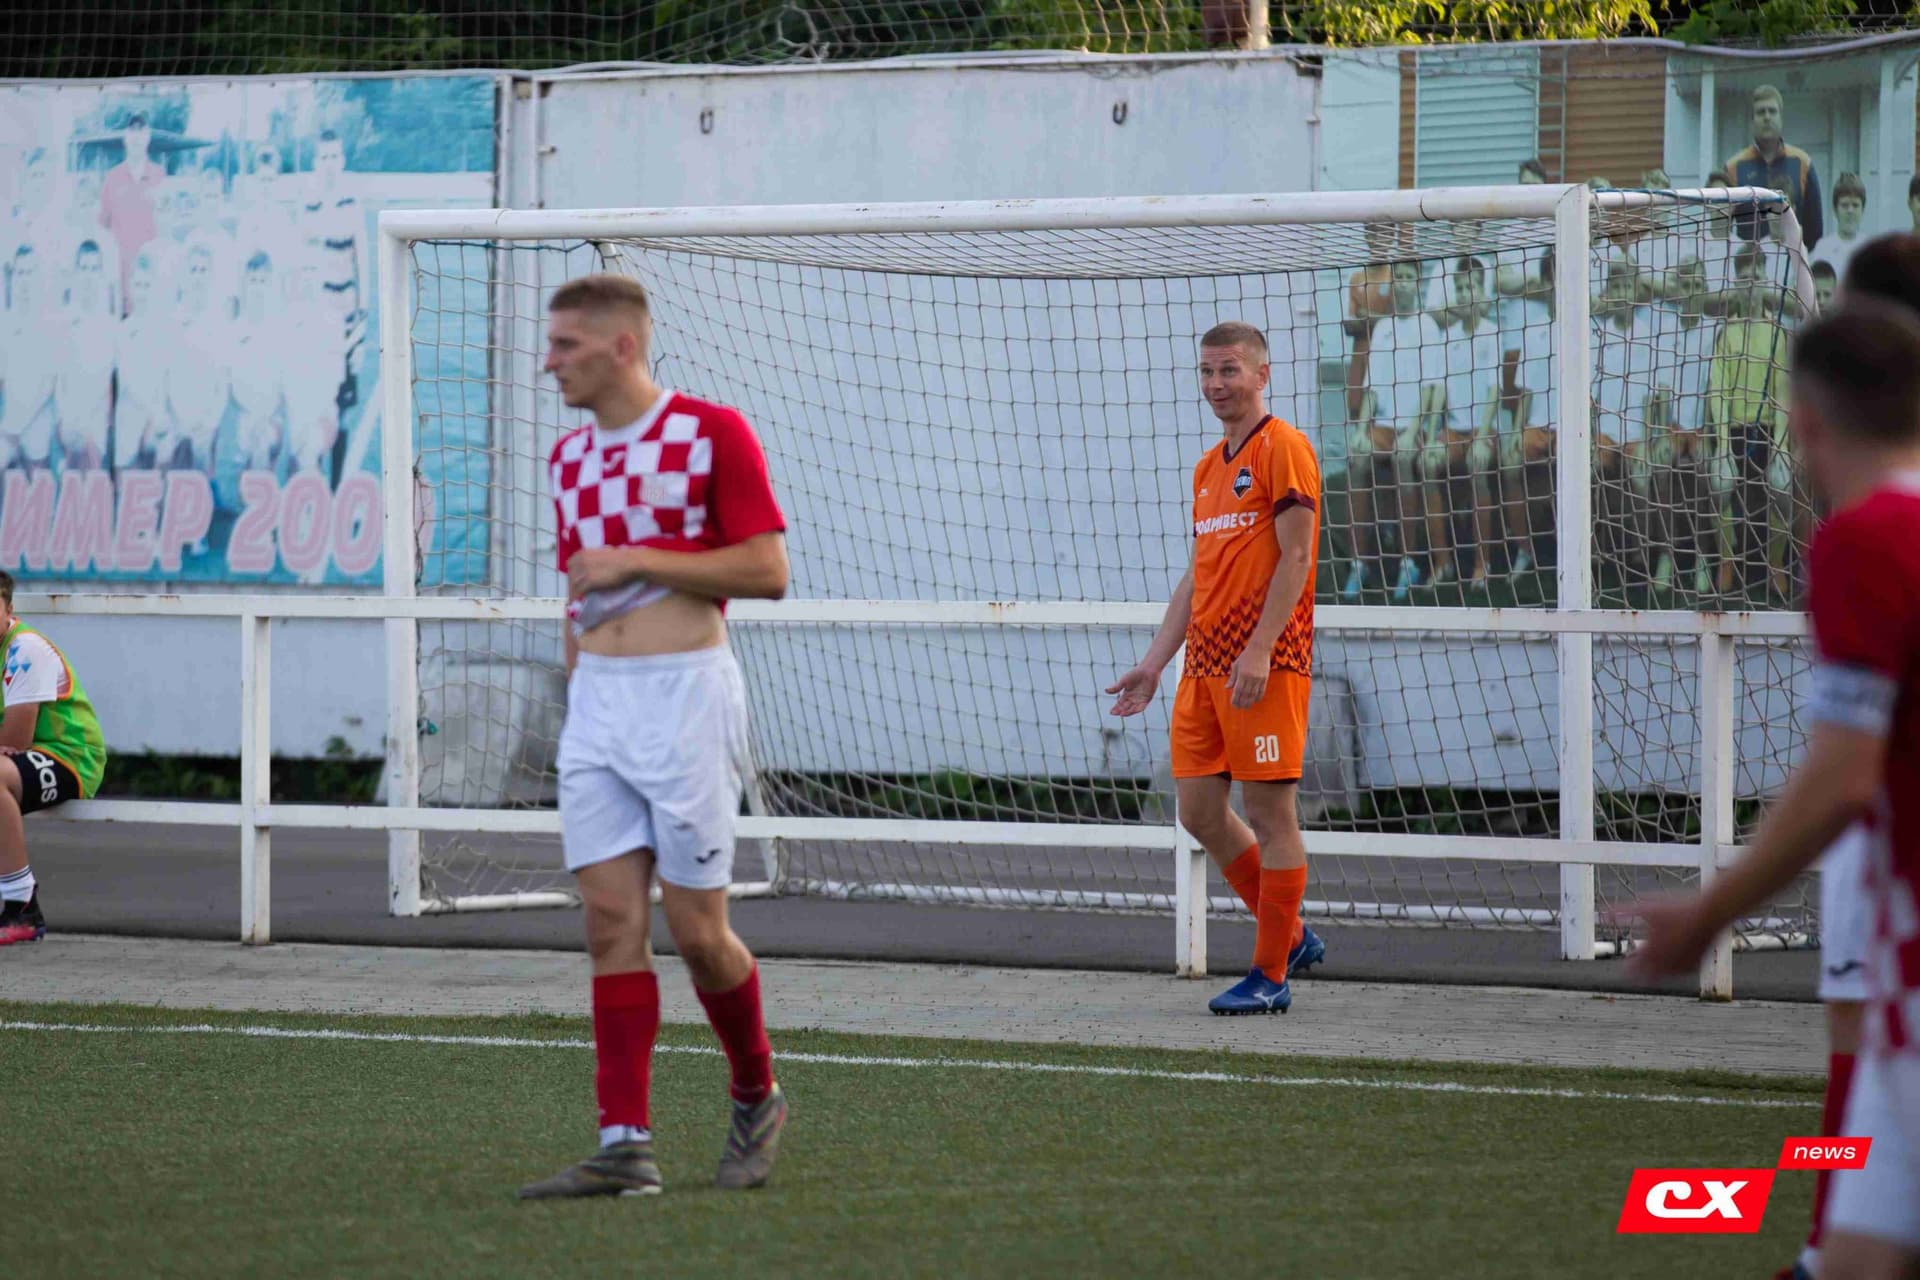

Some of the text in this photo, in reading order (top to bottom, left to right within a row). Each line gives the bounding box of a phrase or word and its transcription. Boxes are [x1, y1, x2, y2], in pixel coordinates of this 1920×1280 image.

[0, 468, 436, 574] ИМЕР 200
[1254, 734, 1280, 763] 20
